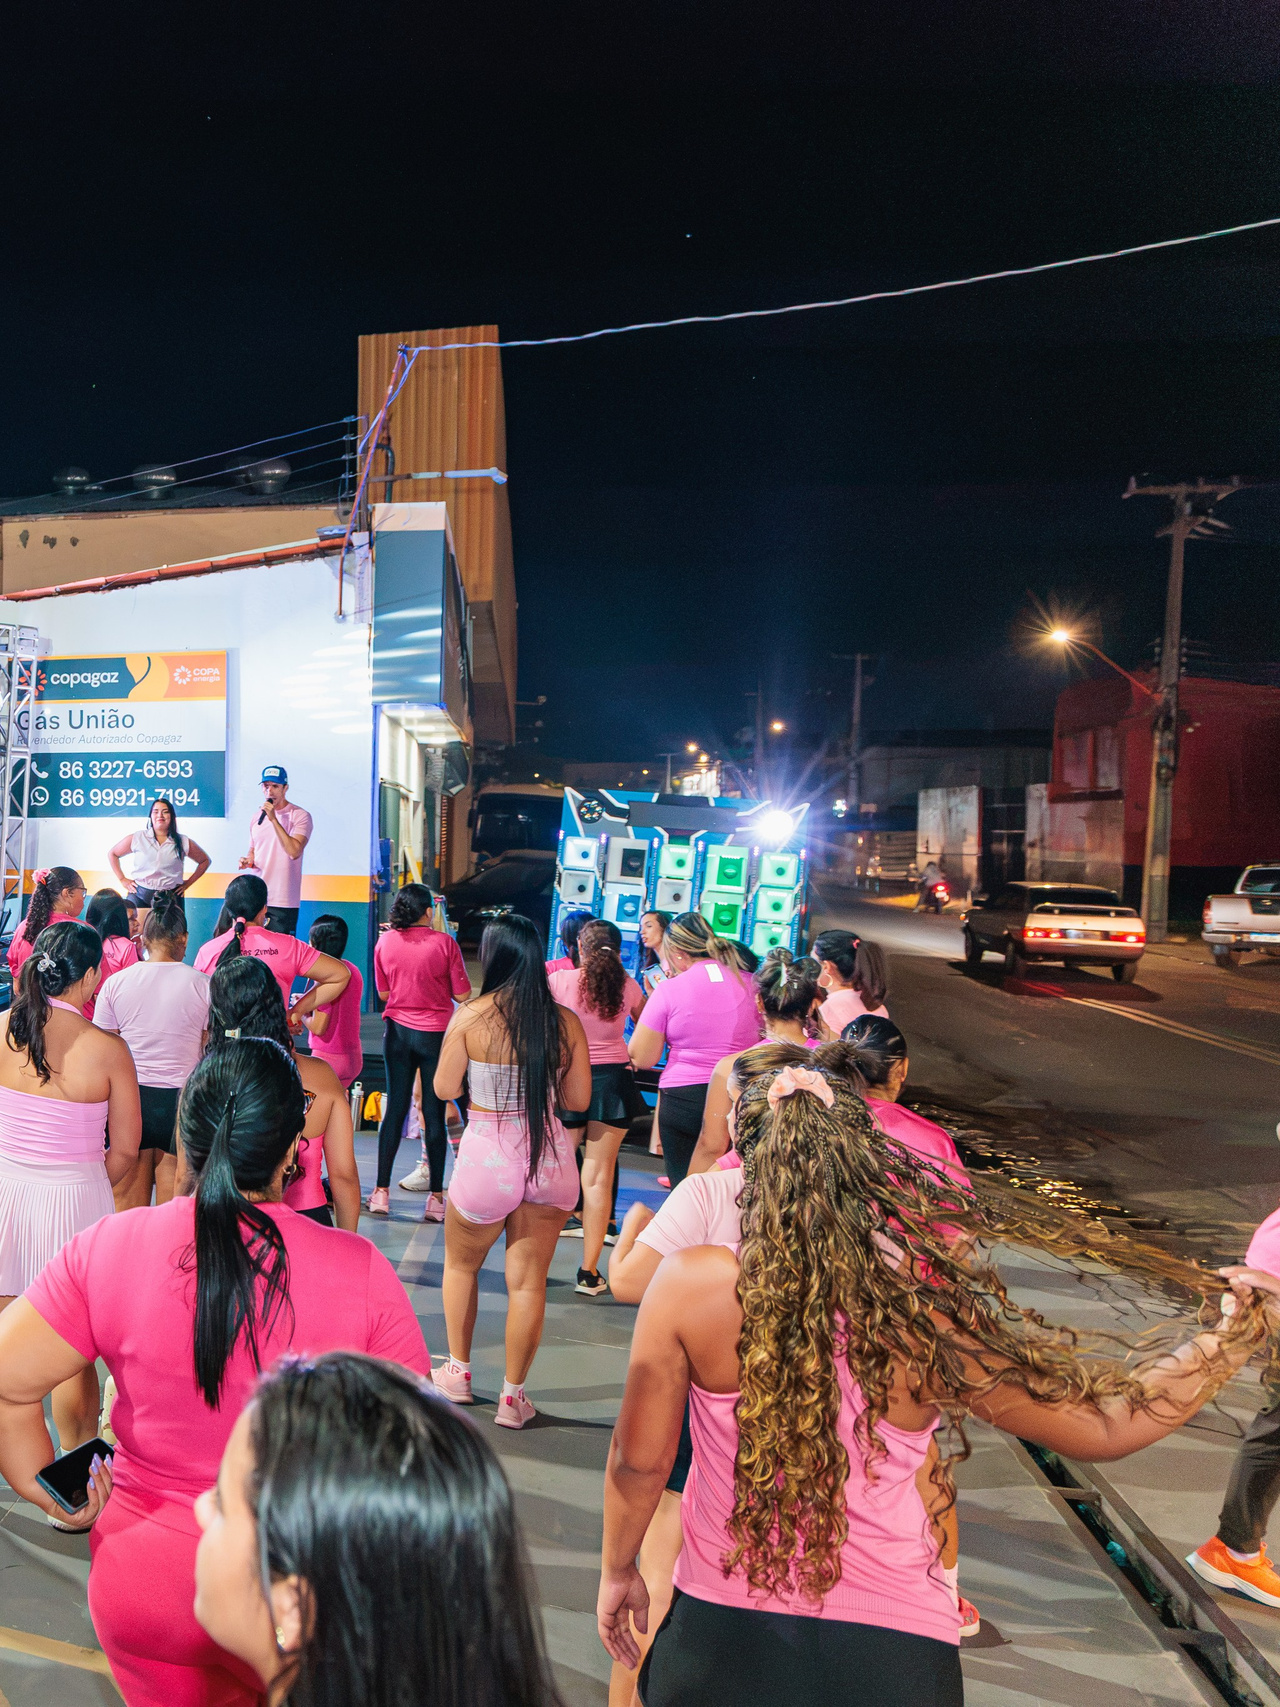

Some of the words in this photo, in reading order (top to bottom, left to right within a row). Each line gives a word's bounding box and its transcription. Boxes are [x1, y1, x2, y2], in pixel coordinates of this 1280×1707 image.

[50, 671, 119, 688] copagaz
[193, 668, 220, 676] COPA
[17, 710, 60, 730] Gás
[68, 708, 135, 730] União
[78, 734, 134, 744] Autorizado
[136, 733, 183, 746] Copagaz
[59, 761, 84, 779] 86
[89, 760, 193, 779] 3227-6593
[60, 788, 85, 807] 86
[90, 788, 201, 807] 99921-7194
